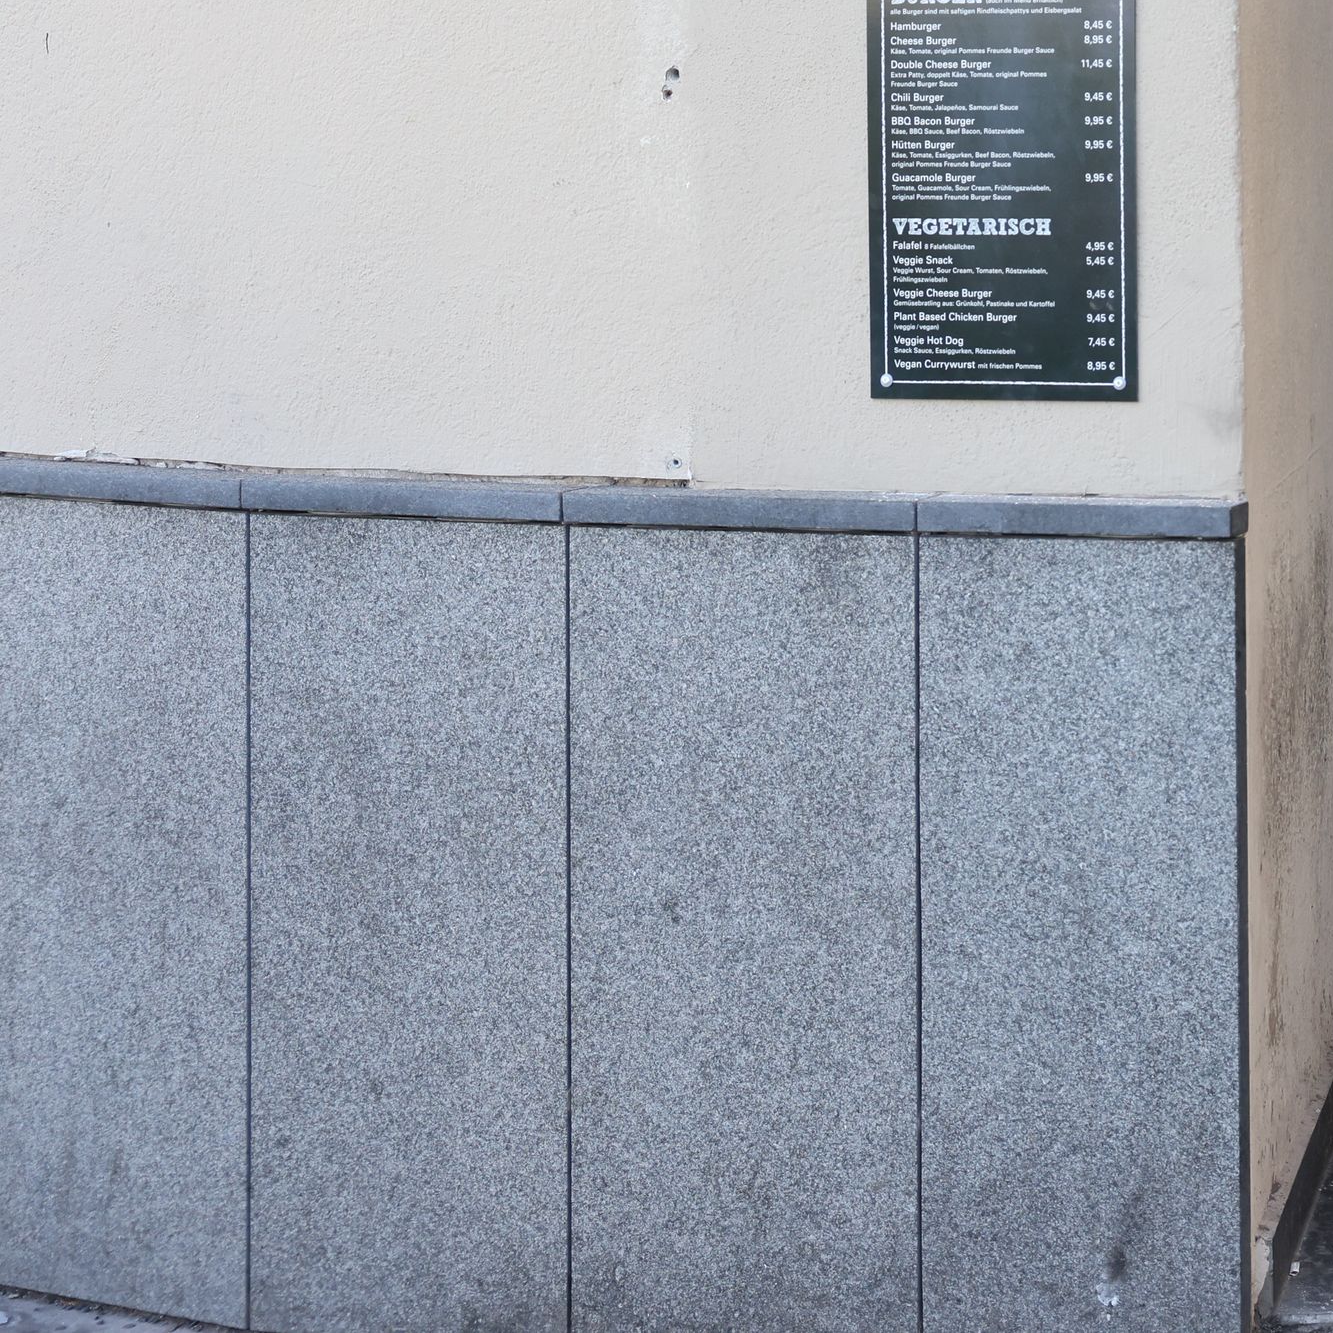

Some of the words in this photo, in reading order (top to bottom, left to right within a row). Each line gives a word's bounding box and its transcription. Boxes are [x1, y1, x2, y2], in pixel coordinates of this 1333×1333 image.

[890, 22, 942, 33] Hamburger
[1084, 20, 1104, 30] 8,45
[891, 60, 923, 69] Double
[925, 59, 958, 69] Cheese
[960, 59, 992, 71] Burger
[1081, 58, 1104, 69] 11,45
[892, 217, 1052, 236] VEGETARISCH
[893, 255, 924, 267] Veggie
[925, 255, 953, 265] Snack
[1086, 256, 1106, 266] 5,45
[894, 311, 917, 321] Plant
[918, 312, 947, 321] Based
[948, 312, 984, 322] Chicken
[986, 312, 1018, 324] Burger
[1086, 313, 1107, 324] 9,45
